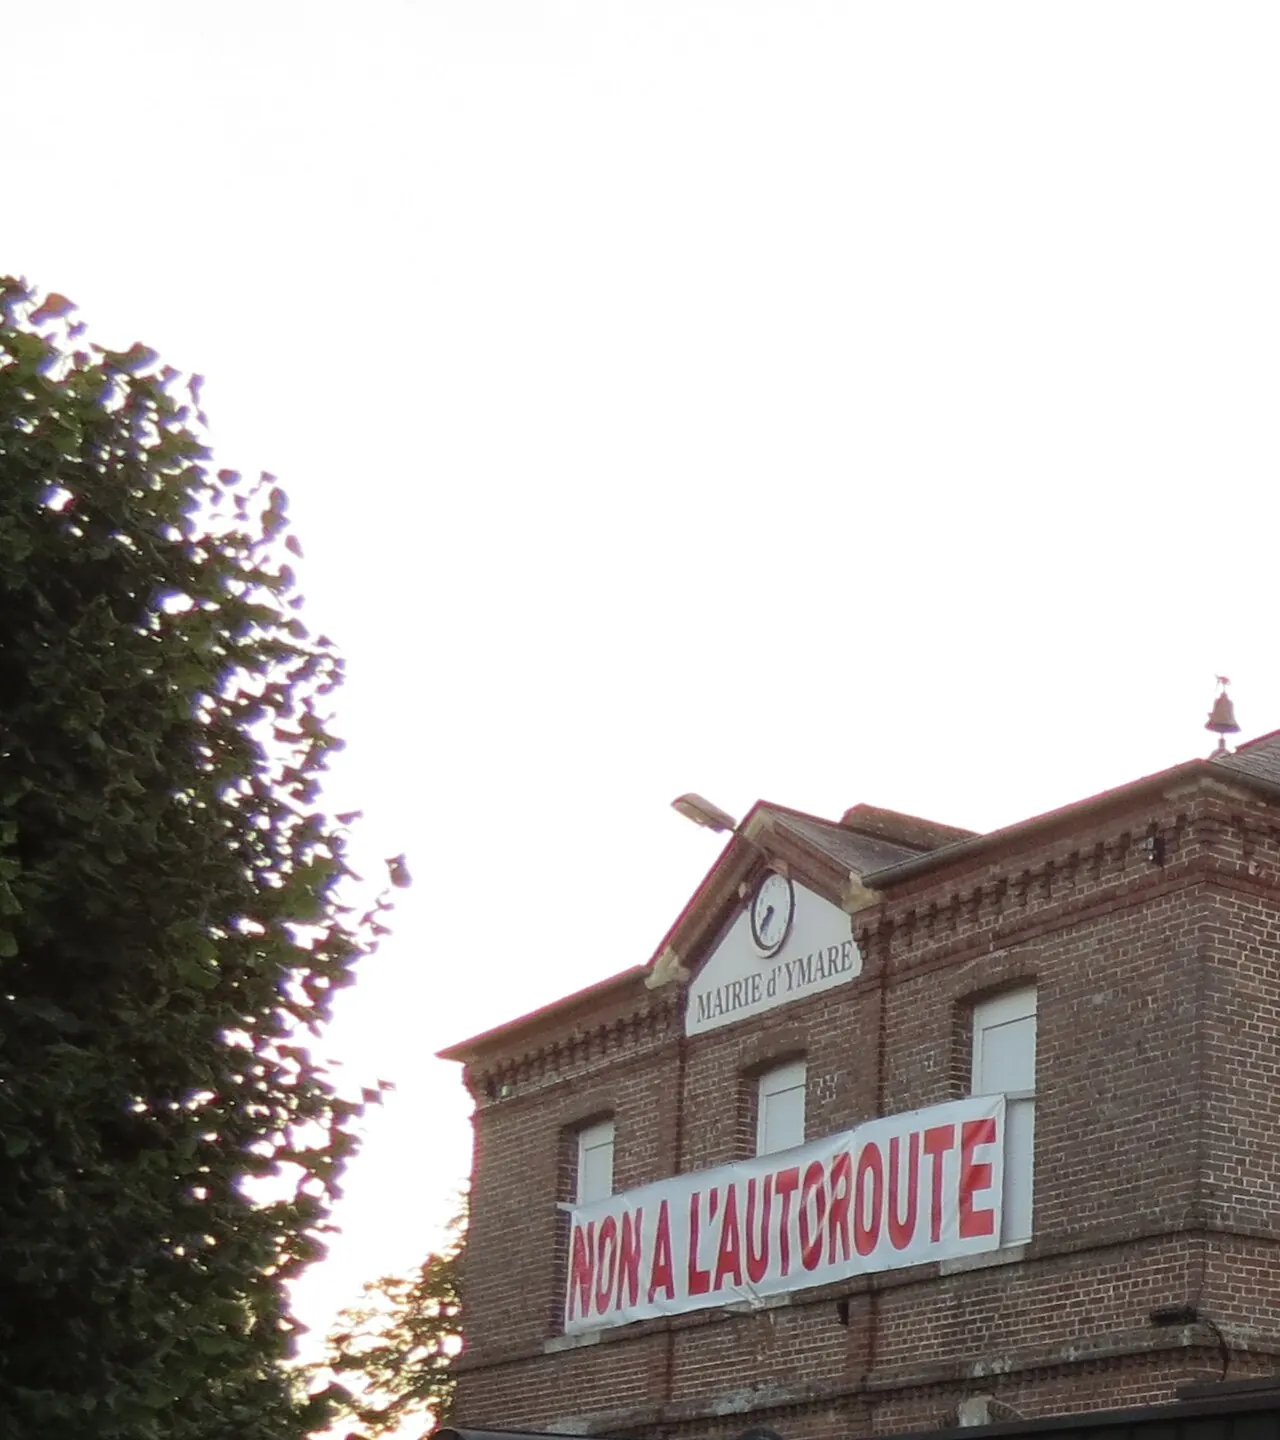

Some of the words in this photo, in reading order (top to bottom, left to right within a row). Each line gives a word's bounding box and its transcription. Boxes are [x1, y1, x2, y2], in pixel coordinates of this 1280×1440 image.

[697, 973, 763, 1023] MAIRIE
[766, 940, 854, 997] d'YMARE
[568, 1206, 643, 1322] NON
[647, 1199, 676, 1304] A
[688, 1117, 997, 1297] L'AUTOROUTE
